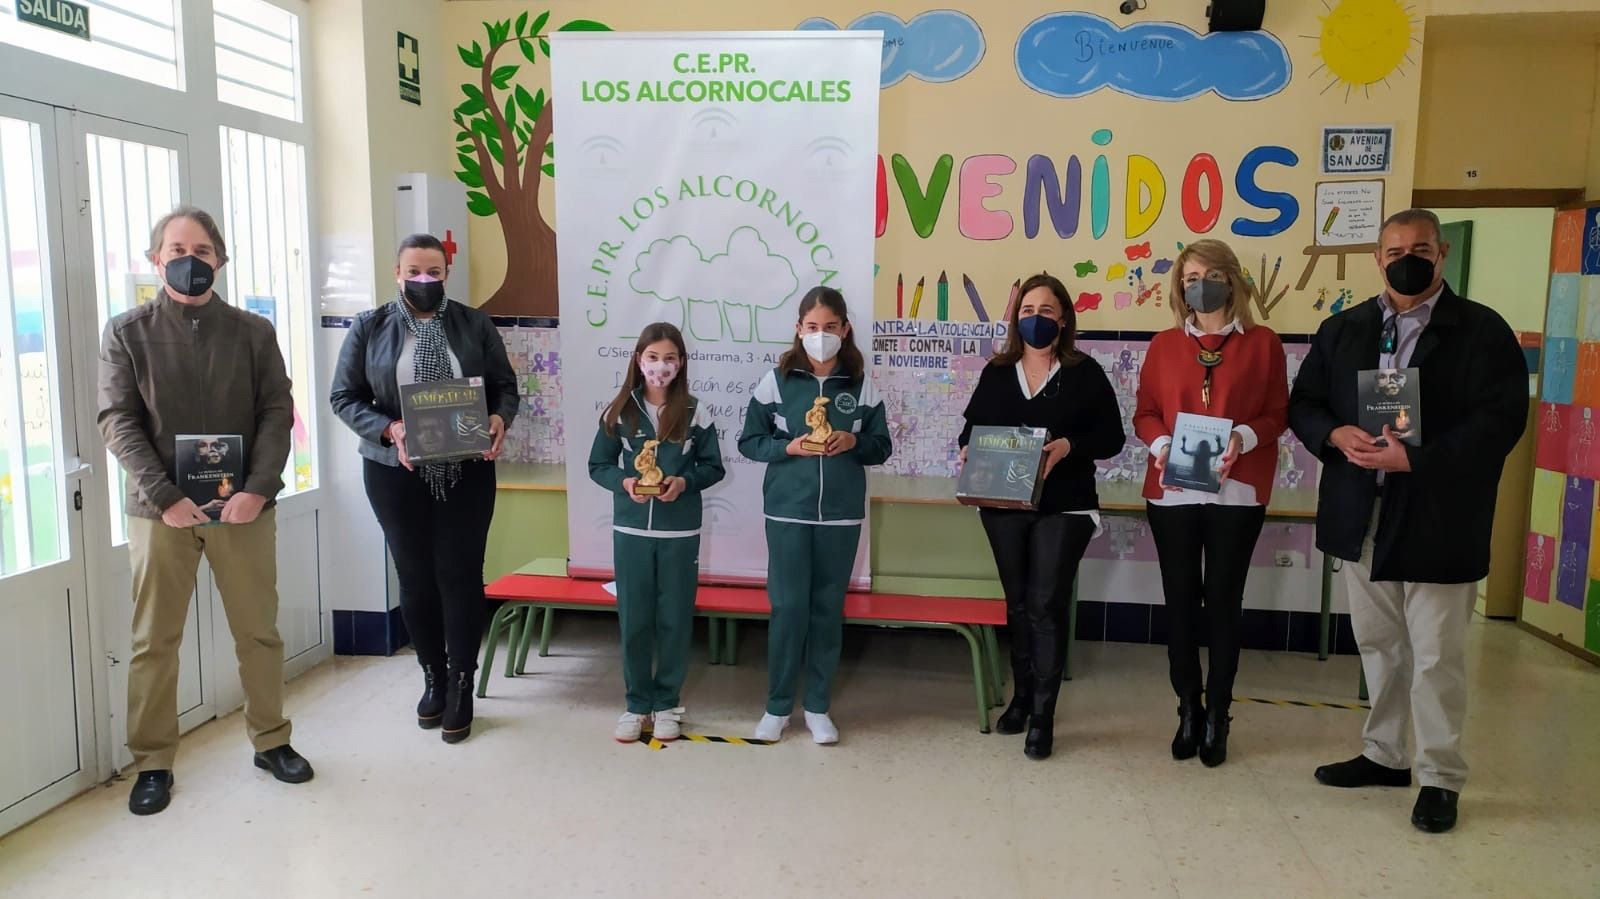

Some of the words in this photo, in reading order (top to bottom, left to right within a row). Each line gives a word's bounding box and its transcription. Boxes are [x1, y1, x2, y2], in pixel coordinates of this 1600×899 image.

[20, 0, 87, 31] SALIDA
[673, 53, 756, 74] C.E.PR.
[581, 80, 631, 103] LOS
[636, 79, 852, 103] ALCORNOCALES
[1350, 135, 1383, 145] AVENIDA
[1329, 154, 1352, 166] SAN
[1355, 154, 1383, 166] JOSE
[1465, 170, 1478, 178] 15
[618, 186, 669, 233] LOS
[678, 174, 843, 294] ALCORNOCA
[872, 320, 916, 335] NTRA
[918, 321, 939, 335] LA
[939, 323, 992, 337] VIOLENCIA
[909, 339, 952, 353] CONTRA
[963, 341, 976, 354] LA
[746, 352, 754, 363] 3
[888, 355, 948, 369] NOVIEMBRE
[726, 379, 745, 394] es
